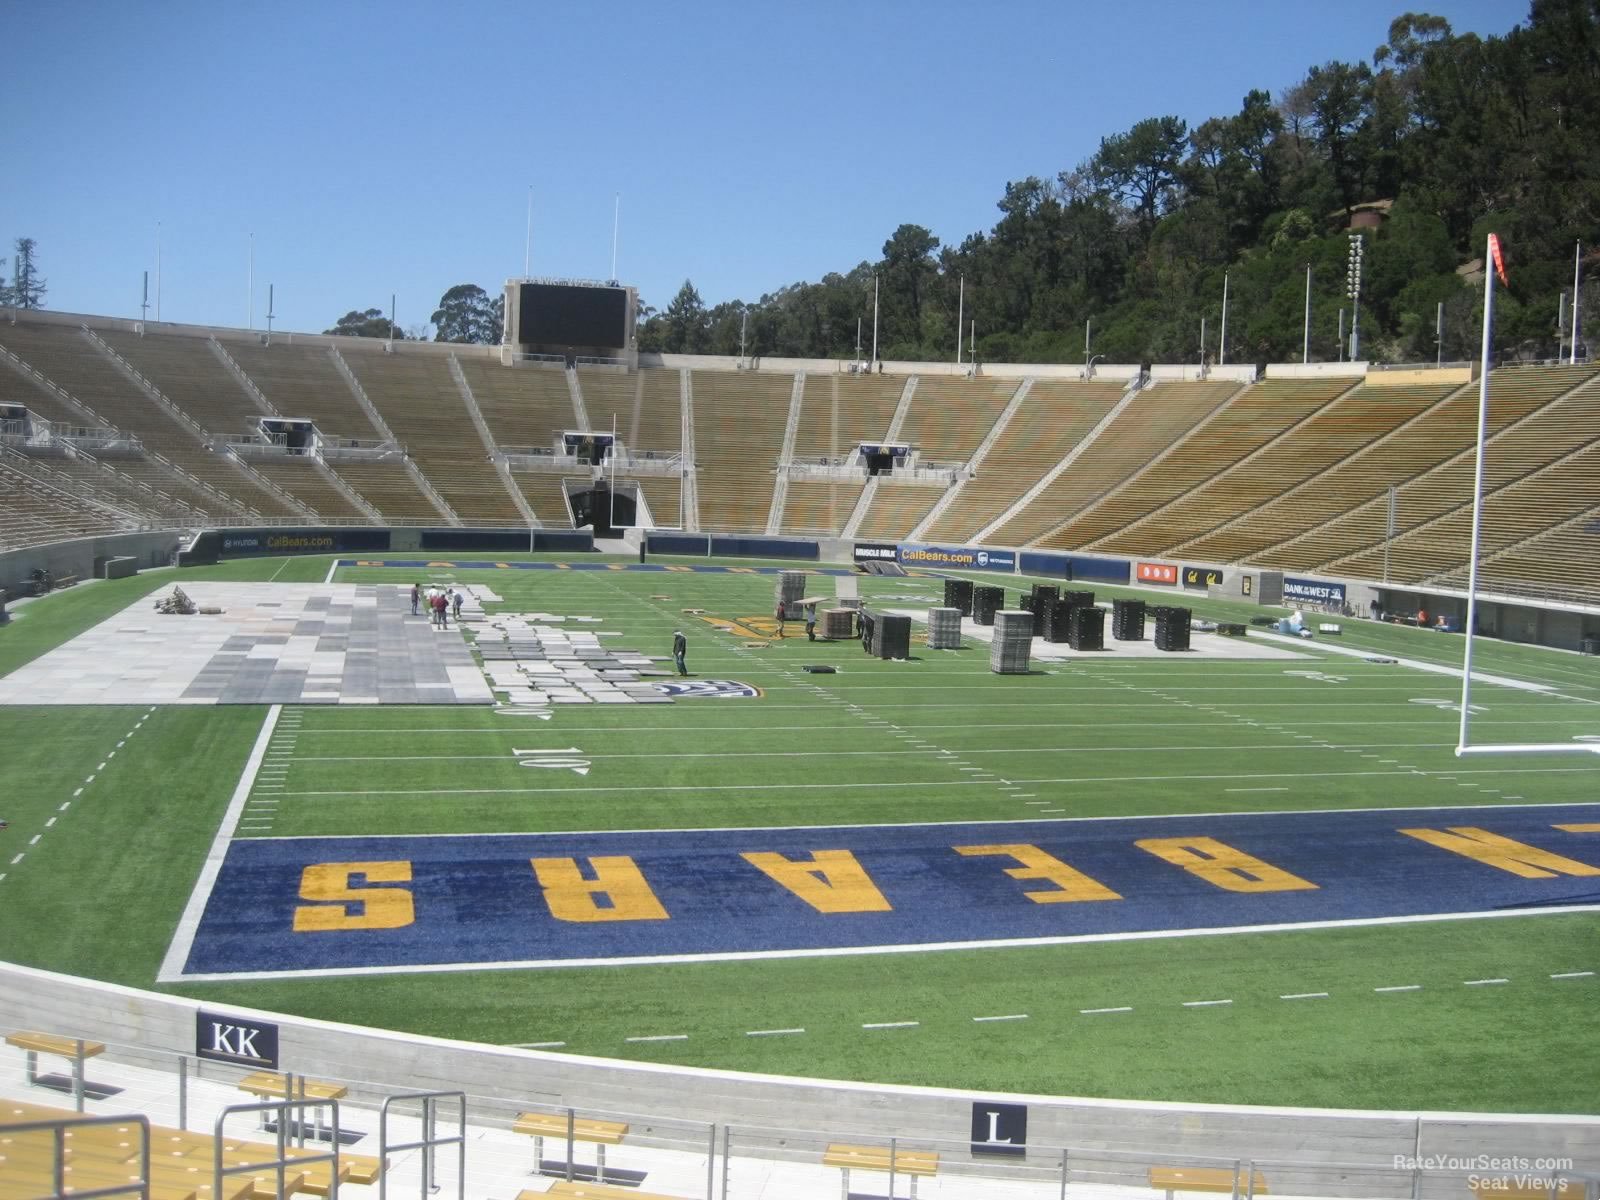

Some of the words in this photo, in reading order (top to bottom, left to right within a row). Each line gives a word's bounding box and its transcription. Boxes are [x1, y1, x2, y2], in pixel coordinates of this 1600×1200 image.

[267, 536, 332, 547] CalBears.com
[855, 547, 880, 557] MUSCLE
[880, 549, 896, 558] MILK
[901, 550, 973, 564] CalBears.com
[1284, 583, 1303, 594] BANK
[1309, 587, 1330, 598] WEST
[212, 1022, 261, 1058] KK
[986, 1111, 1012, 1144] L
